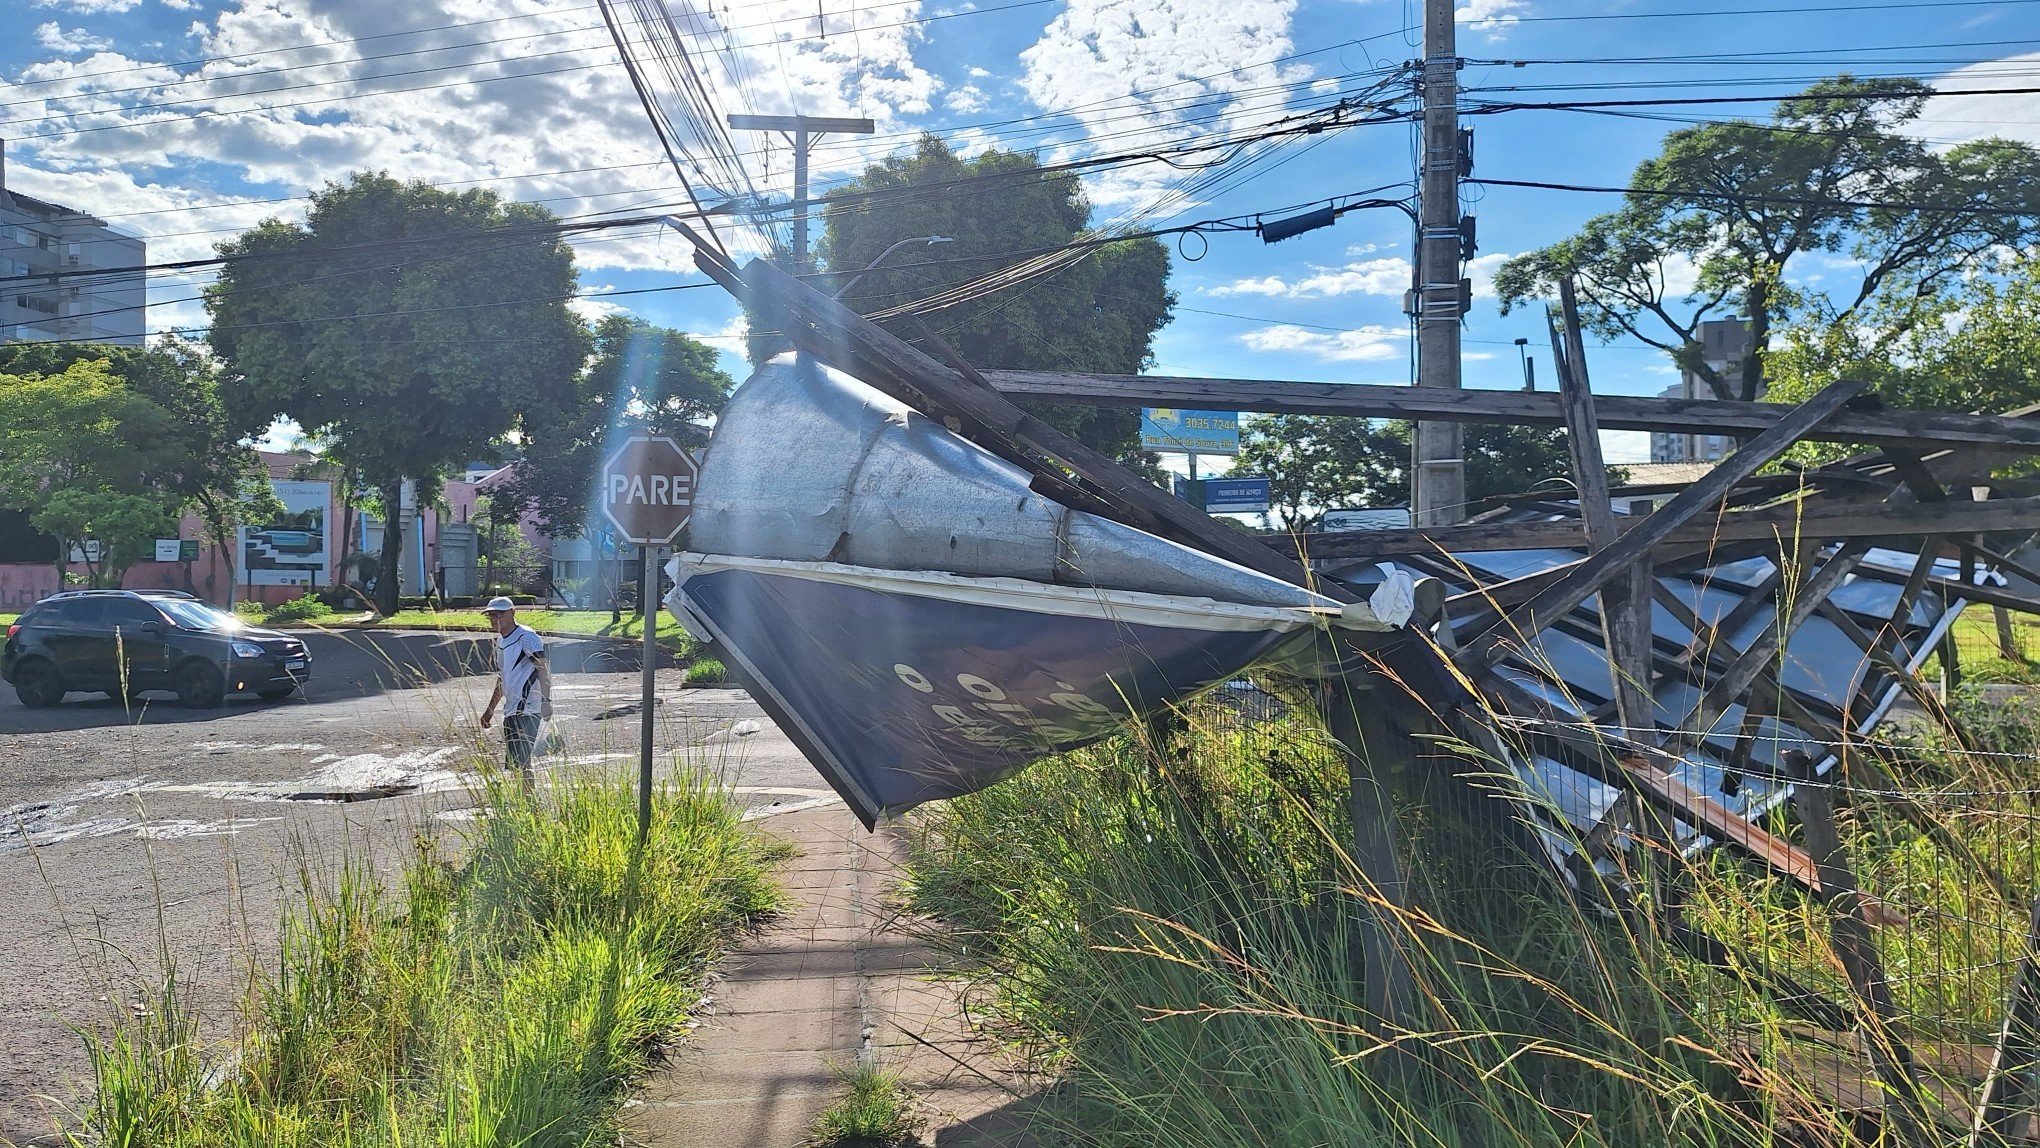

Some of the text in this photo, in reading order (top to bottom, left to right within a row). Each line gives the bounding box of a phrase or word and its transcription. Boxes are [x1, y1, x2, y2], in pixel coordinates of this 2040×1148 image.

[1185, 417, 1236, 431] 3035.7244
[1146, 434, 1160, 444] Rua
[610, 474, 690, 506] PARE
